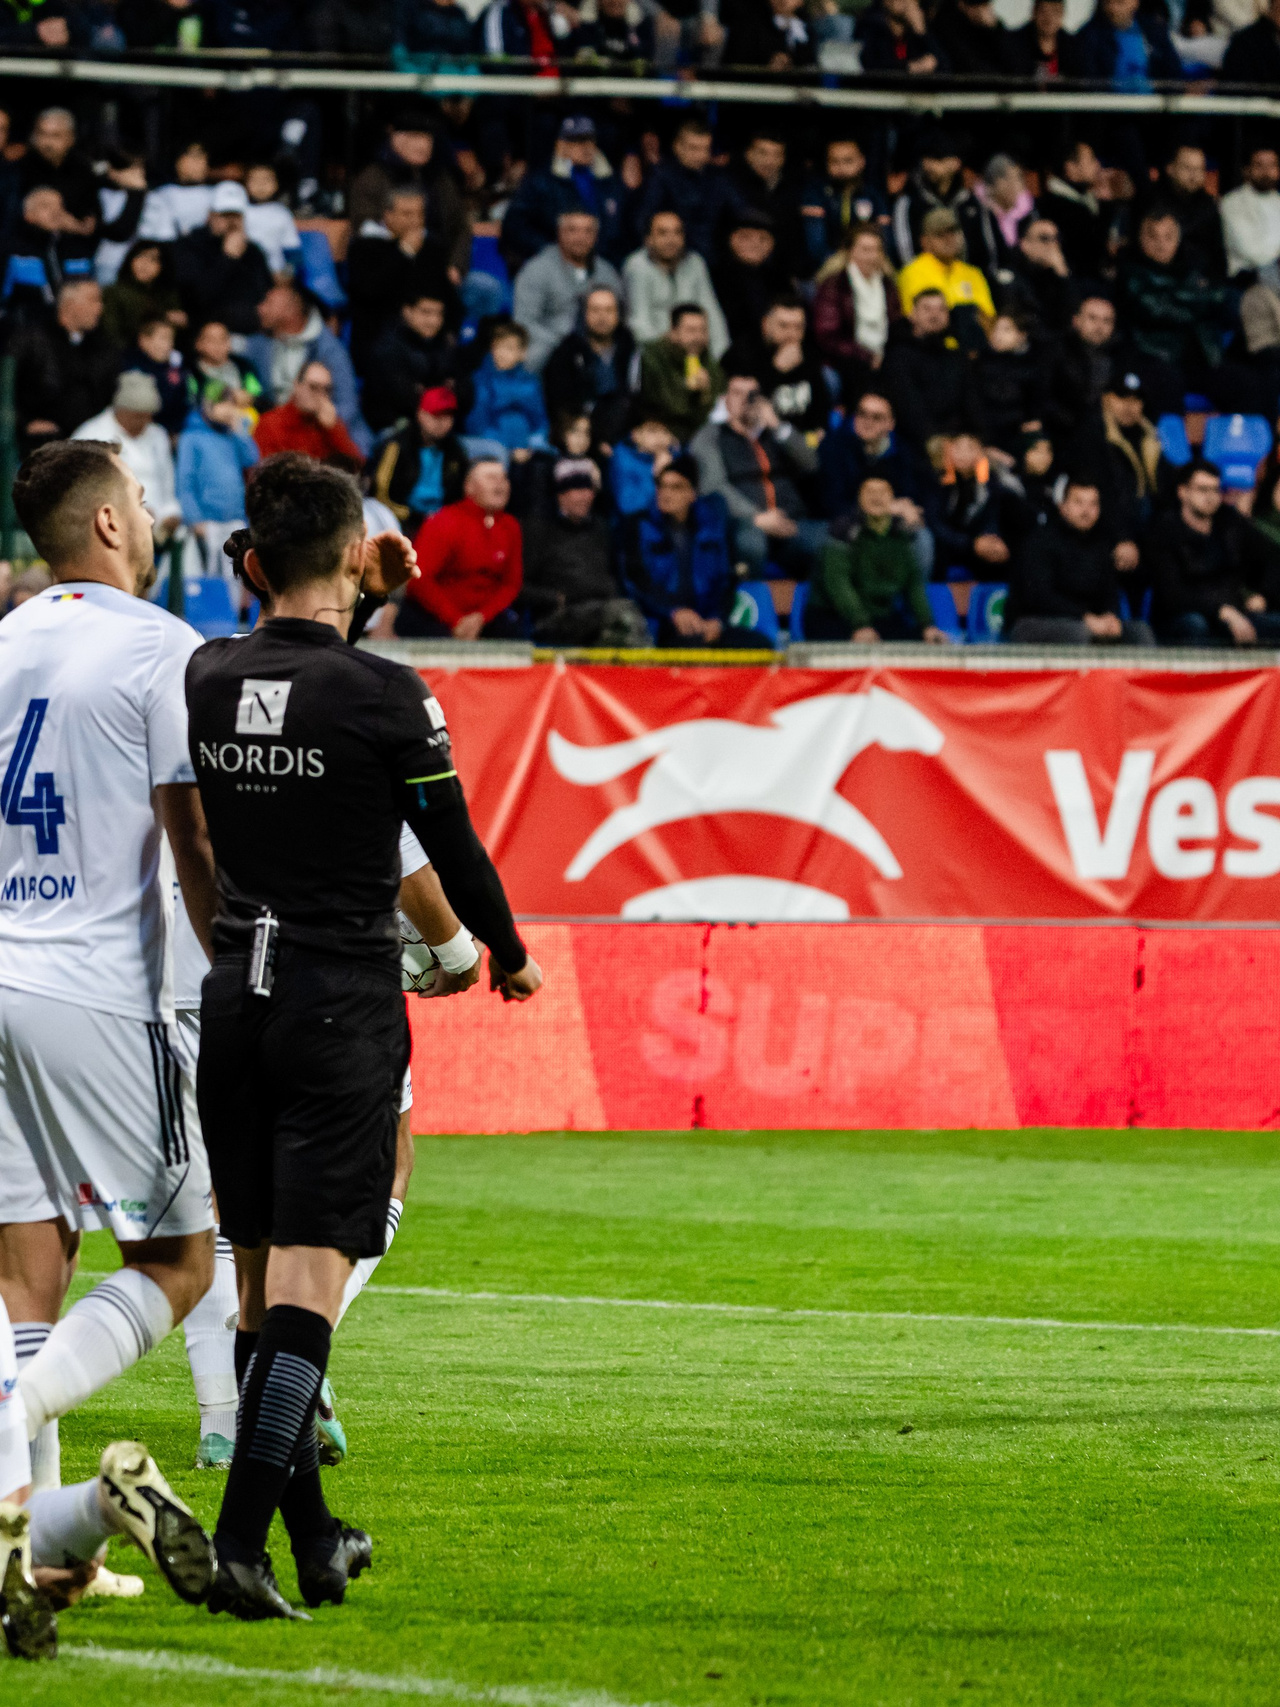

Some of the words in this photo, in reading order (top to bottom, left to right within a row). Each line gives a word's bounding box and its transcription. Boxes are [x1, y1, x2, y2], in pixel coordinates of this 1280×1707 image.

[199, 741, 325, 778] NORDIS
[0, 698, 66, 855] 4
[236, 783, 278, 793] GROUP
[1, 875, 76, 901] MIRON
